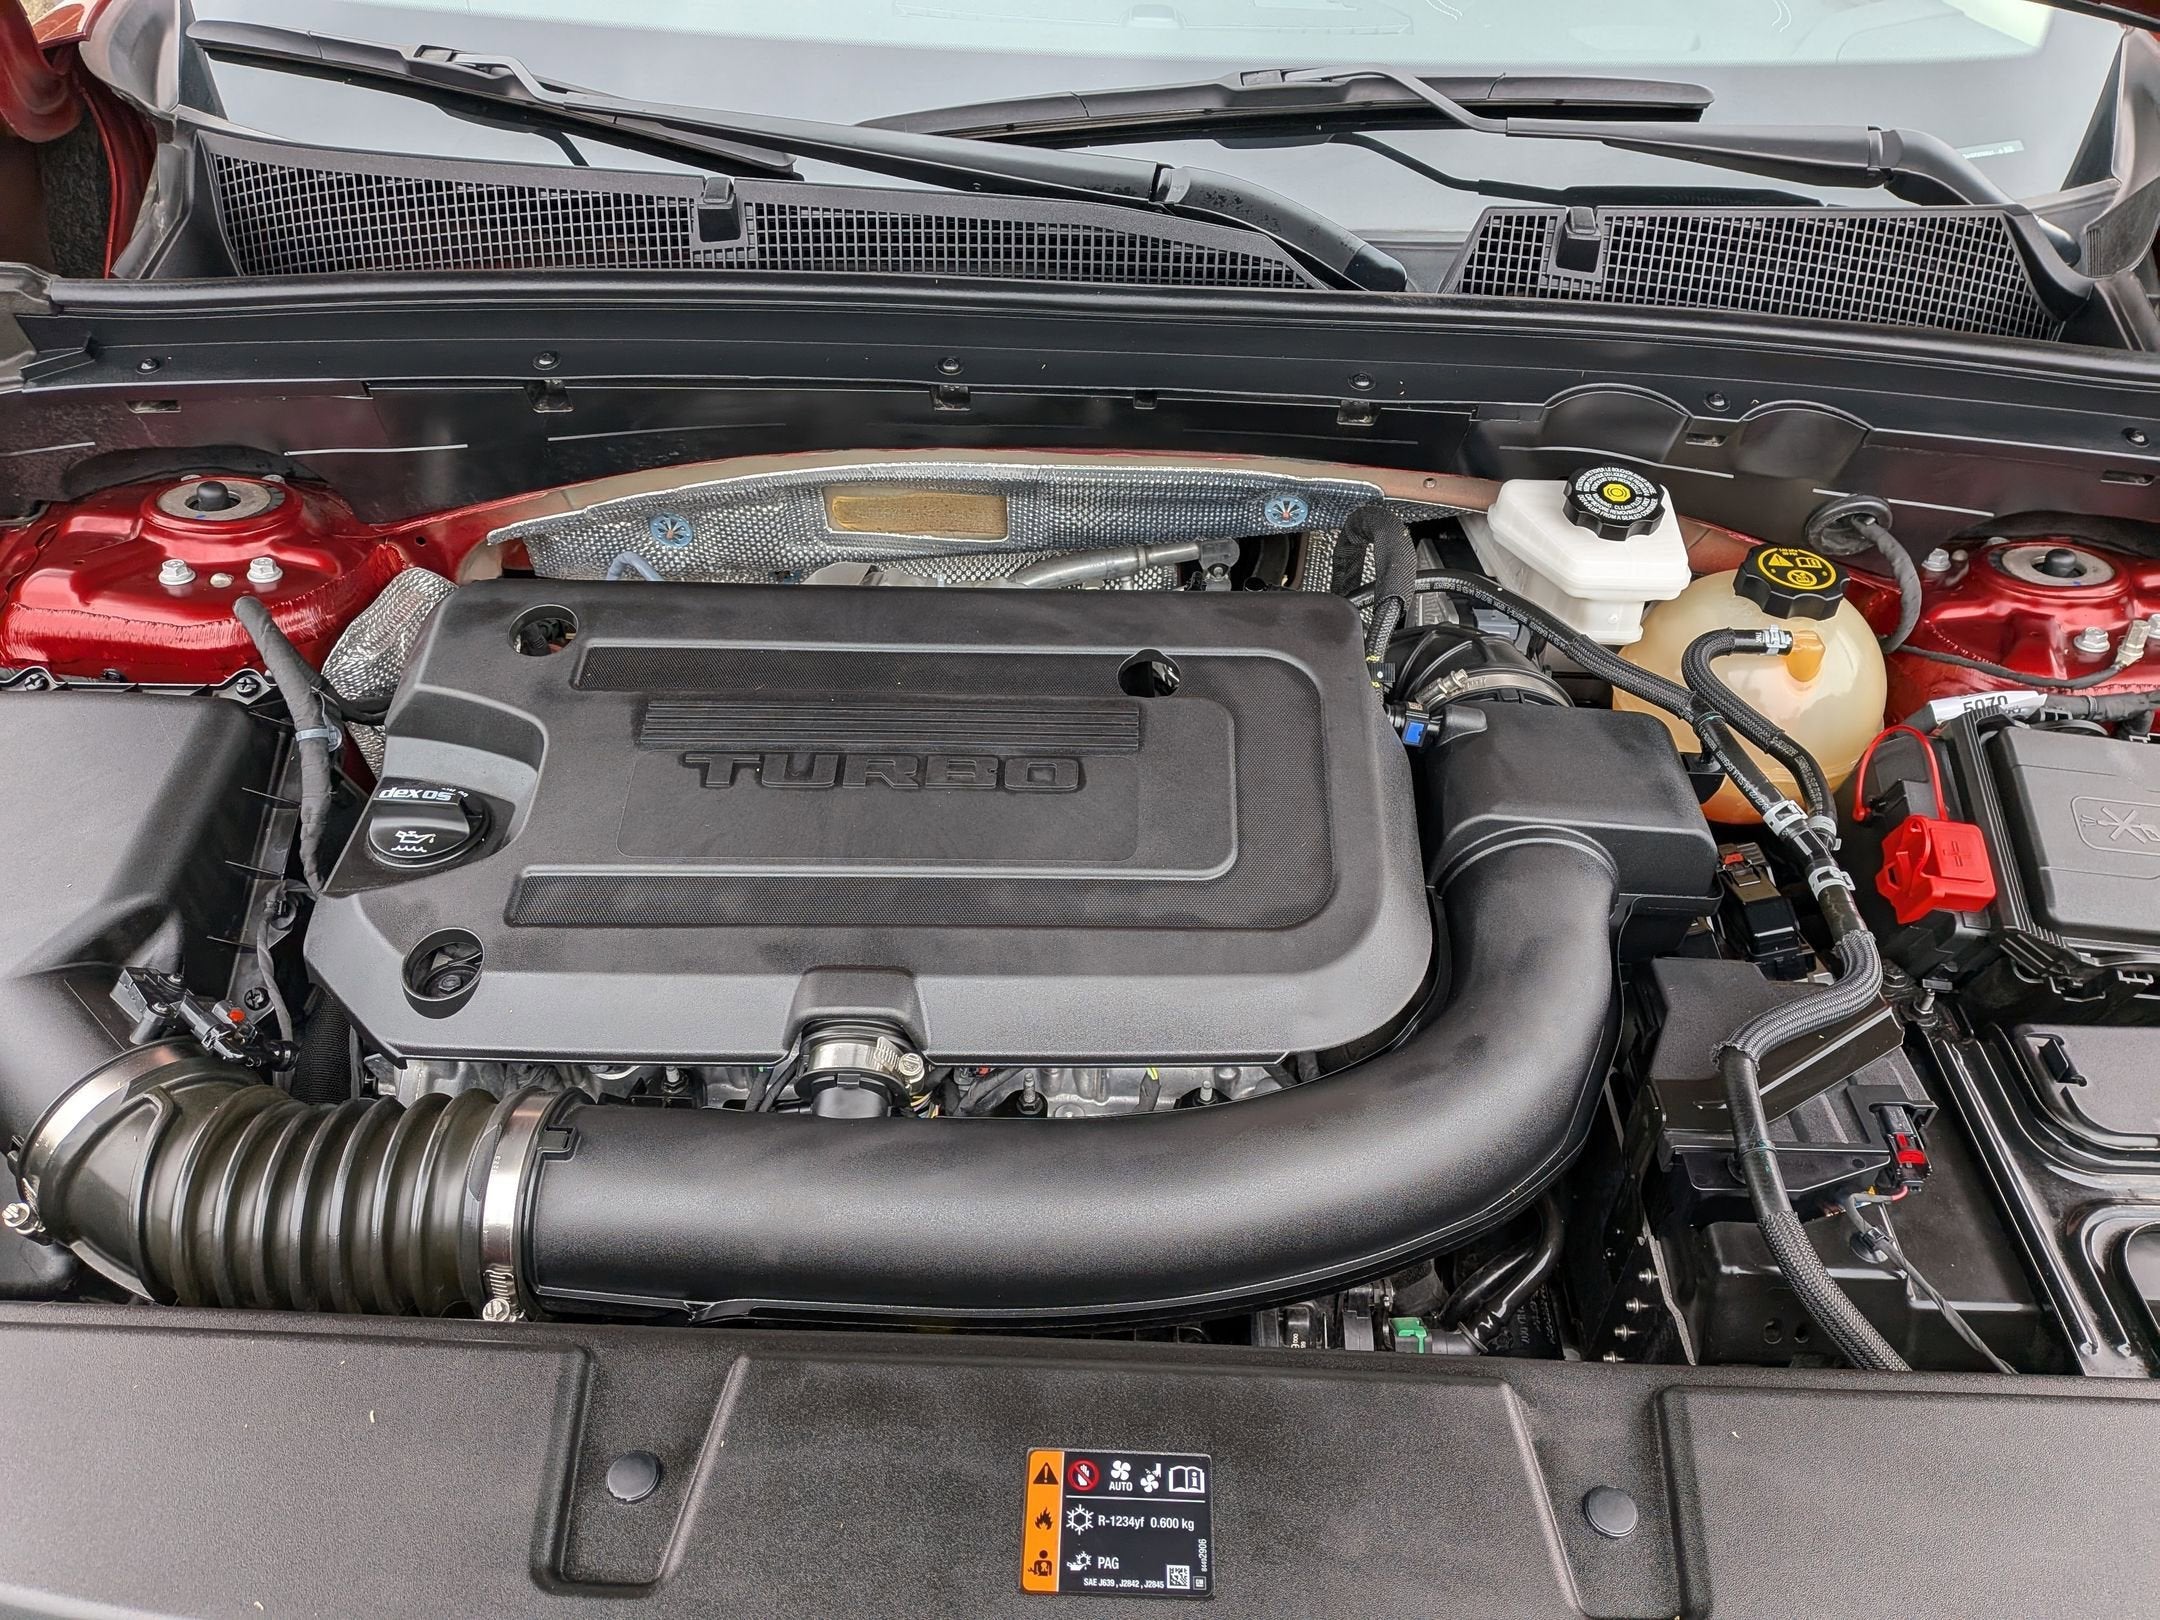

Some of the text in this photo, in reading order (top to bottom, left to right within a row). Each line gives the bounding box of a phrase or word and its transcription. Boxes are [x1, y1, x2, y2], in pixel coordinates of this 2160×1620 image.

[684, 752, 1080, 791] TURBO
[379, 787, 456, 801] dexos
[1109, 1481, 1133, 1492] AUTO
[1098, 1515, 1195, 1531] R-1234yf 0.600 kg
[1098, 1556, 1120, 1570] PAG
[1083, 1577, 1097, 1586] SAE
